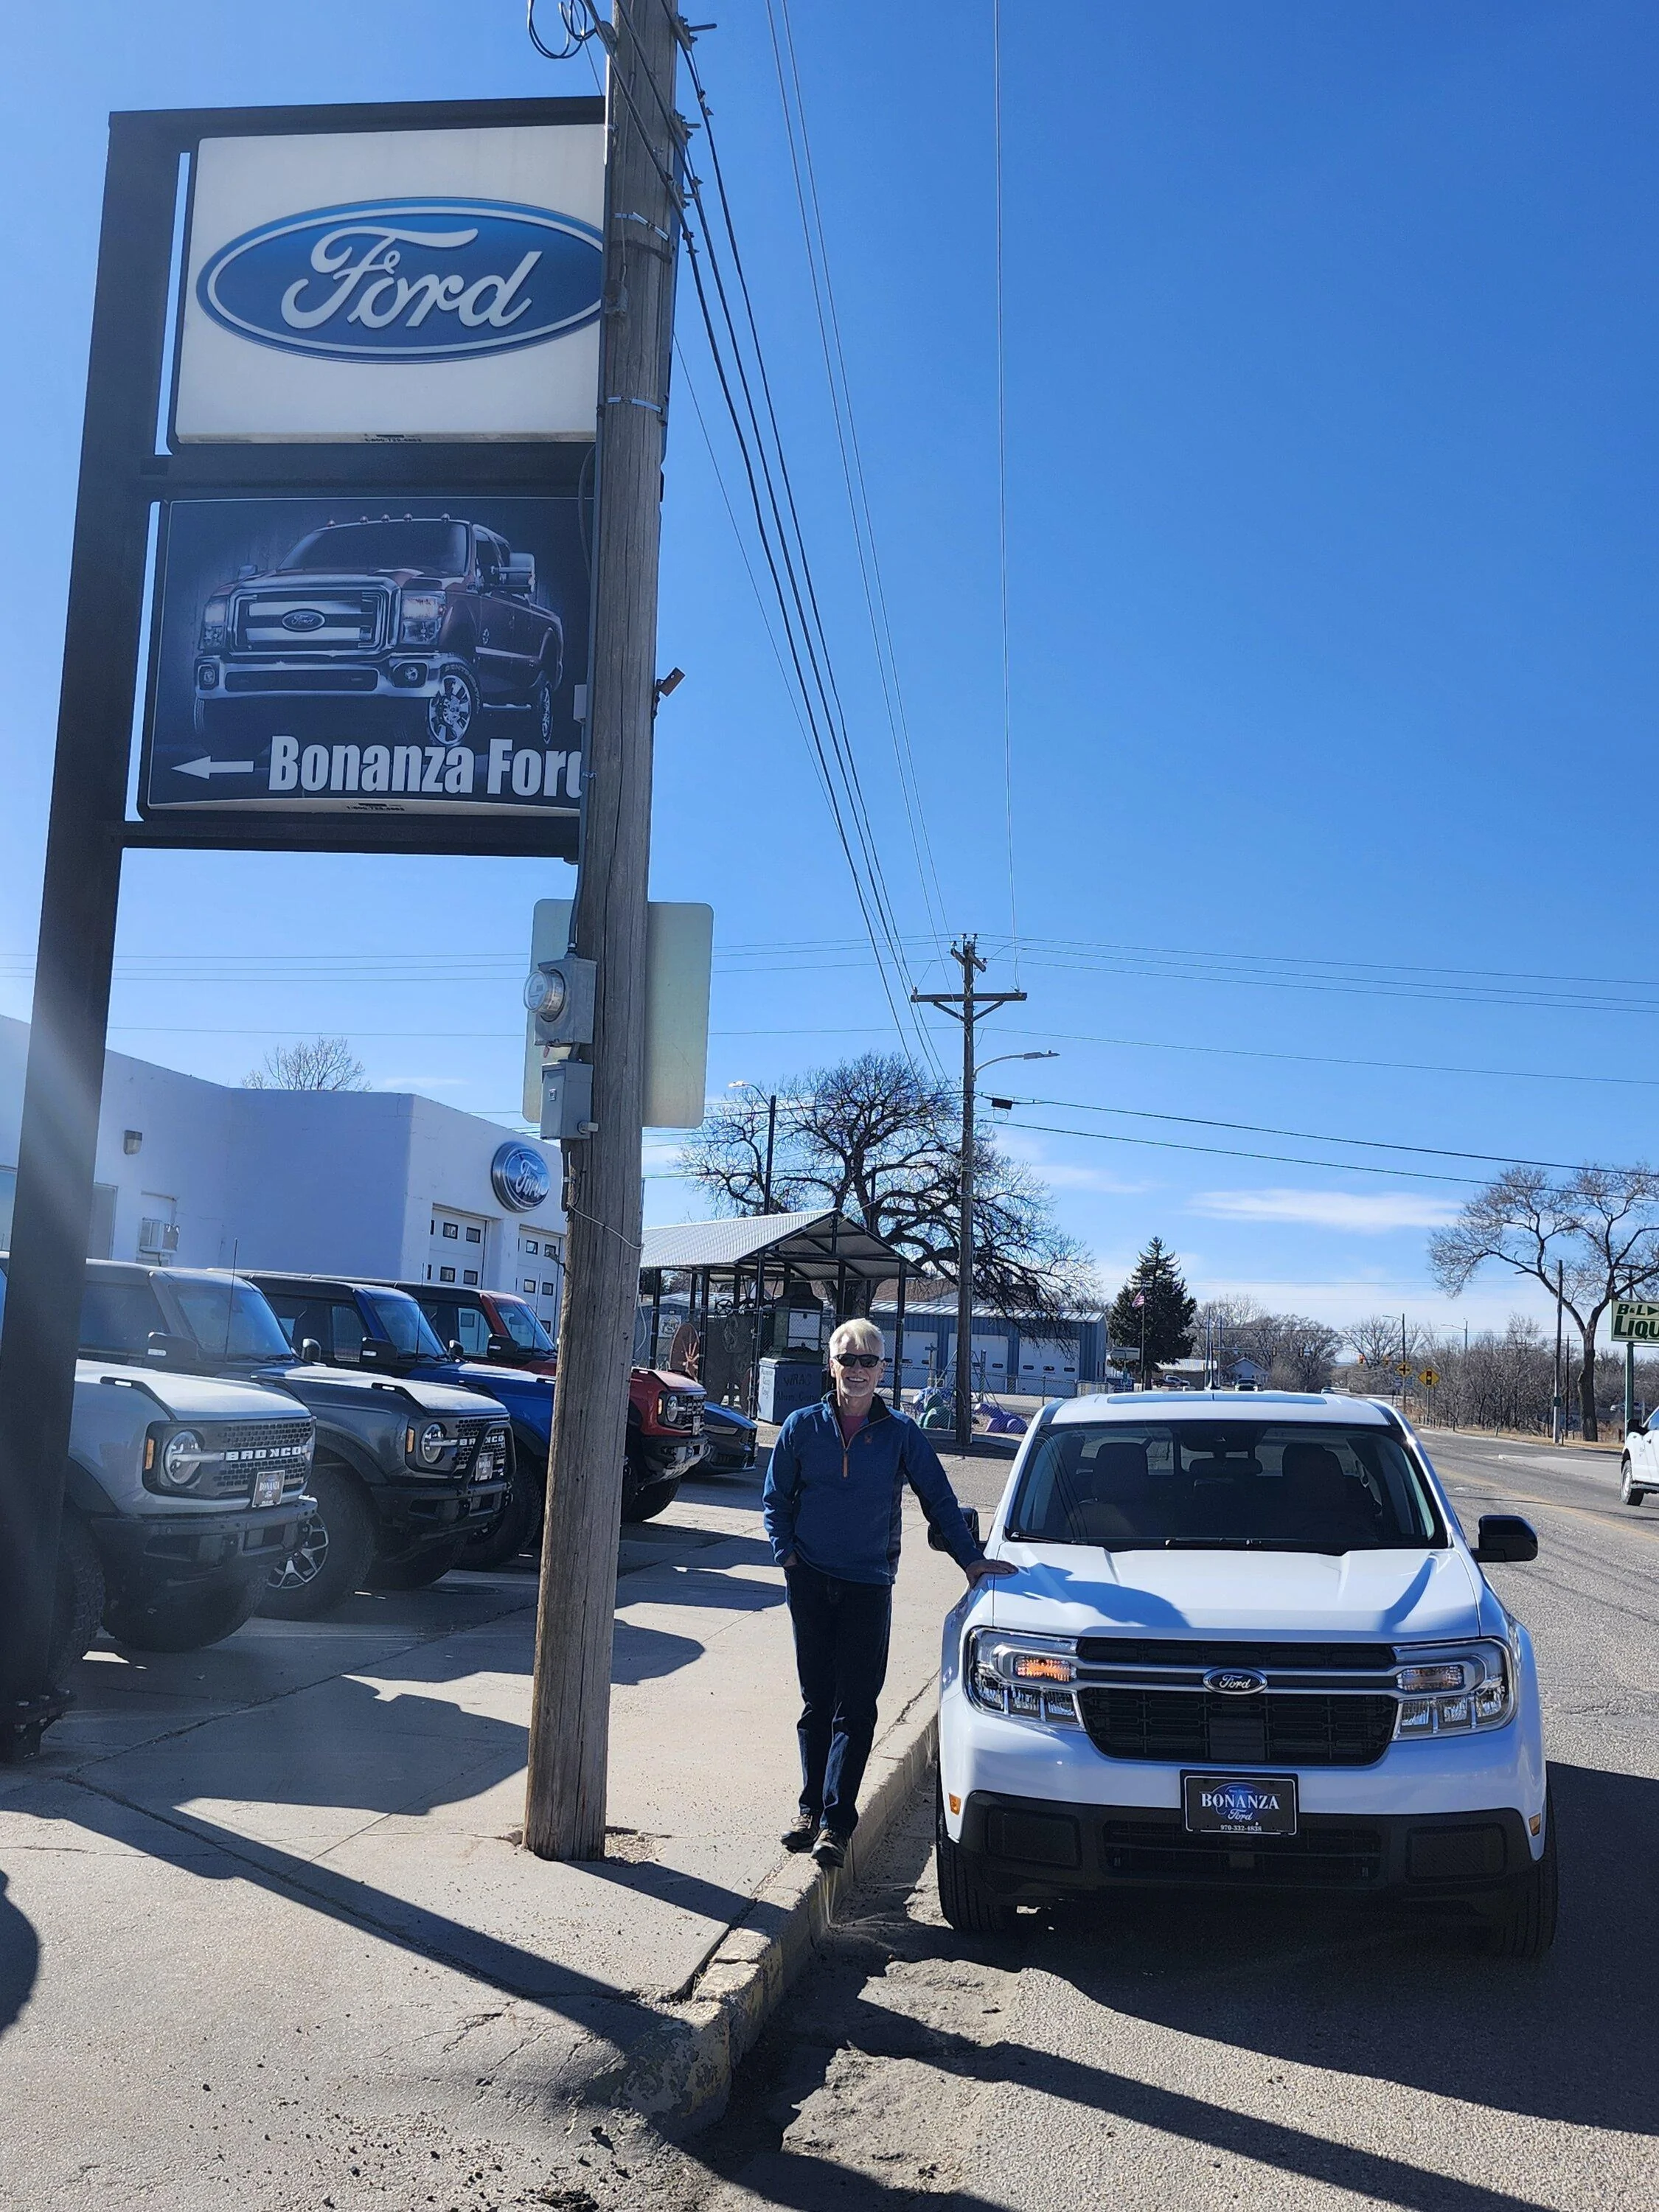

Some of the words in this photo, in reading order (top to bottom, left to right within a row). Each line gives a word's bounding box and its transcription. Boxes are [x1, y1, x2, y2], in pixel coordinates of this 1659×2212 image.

[281, 226, 543, 329] Ford
[268, 736, 475, 794] Bonanza
[459, 1435, 504, 1446] BRNCO
[226, 1446, 302, 1461] BRONCO
[1219, 1674, 1252, 1689] Ford
[1201, 1793, 1281, 1809] BONANZA
[1227, 1809, 1253, 1821] Ford
